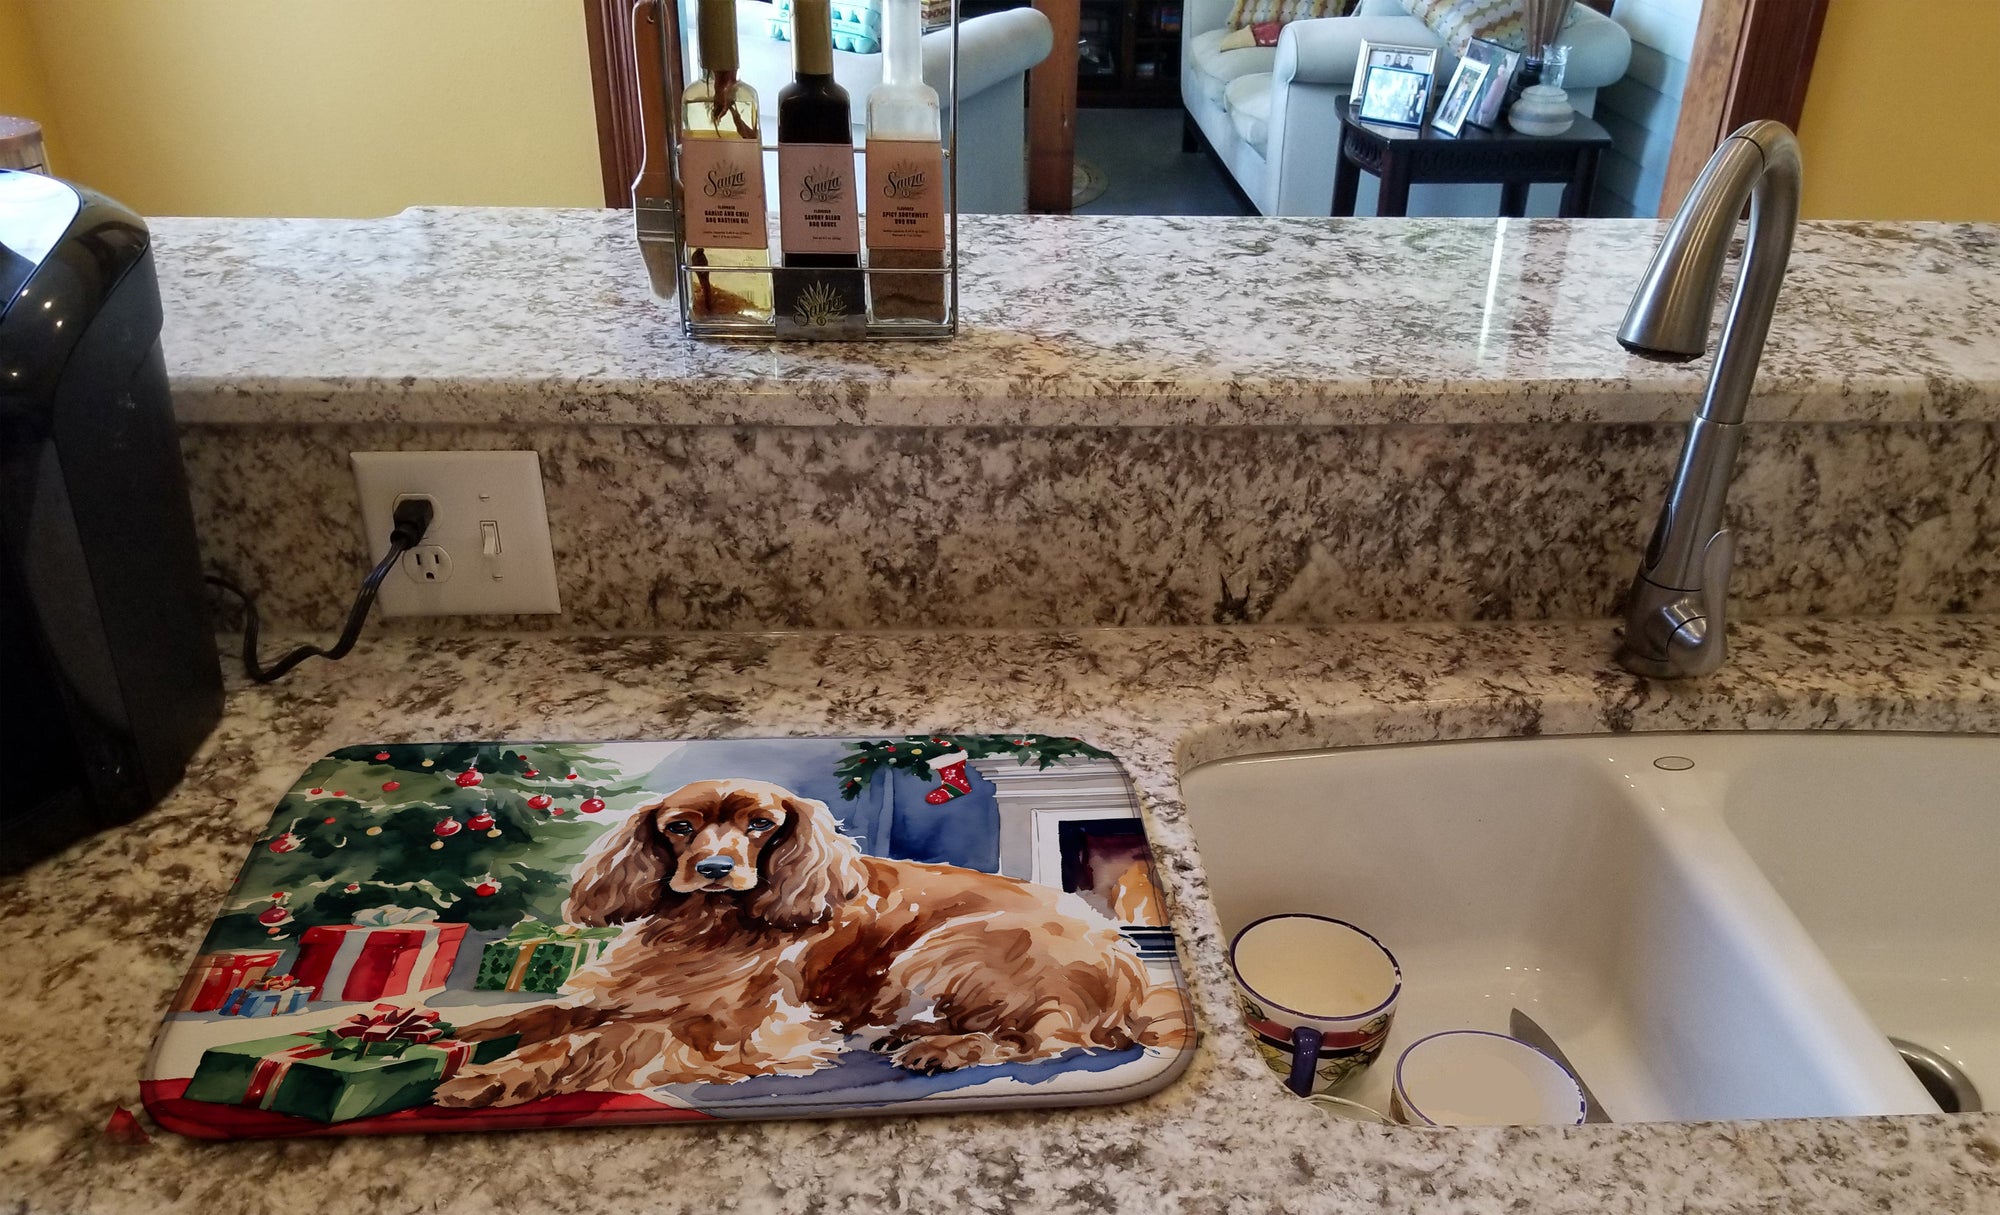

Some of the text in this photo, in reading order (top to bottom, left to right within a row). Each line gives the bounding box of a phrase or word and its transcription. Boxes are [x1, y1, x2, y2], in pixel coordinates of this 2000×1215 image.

[704, 170, 745, 197] Sauza
[800, 176, 841, 202] Sauza
[884, 171, 925, 198] Sauza
